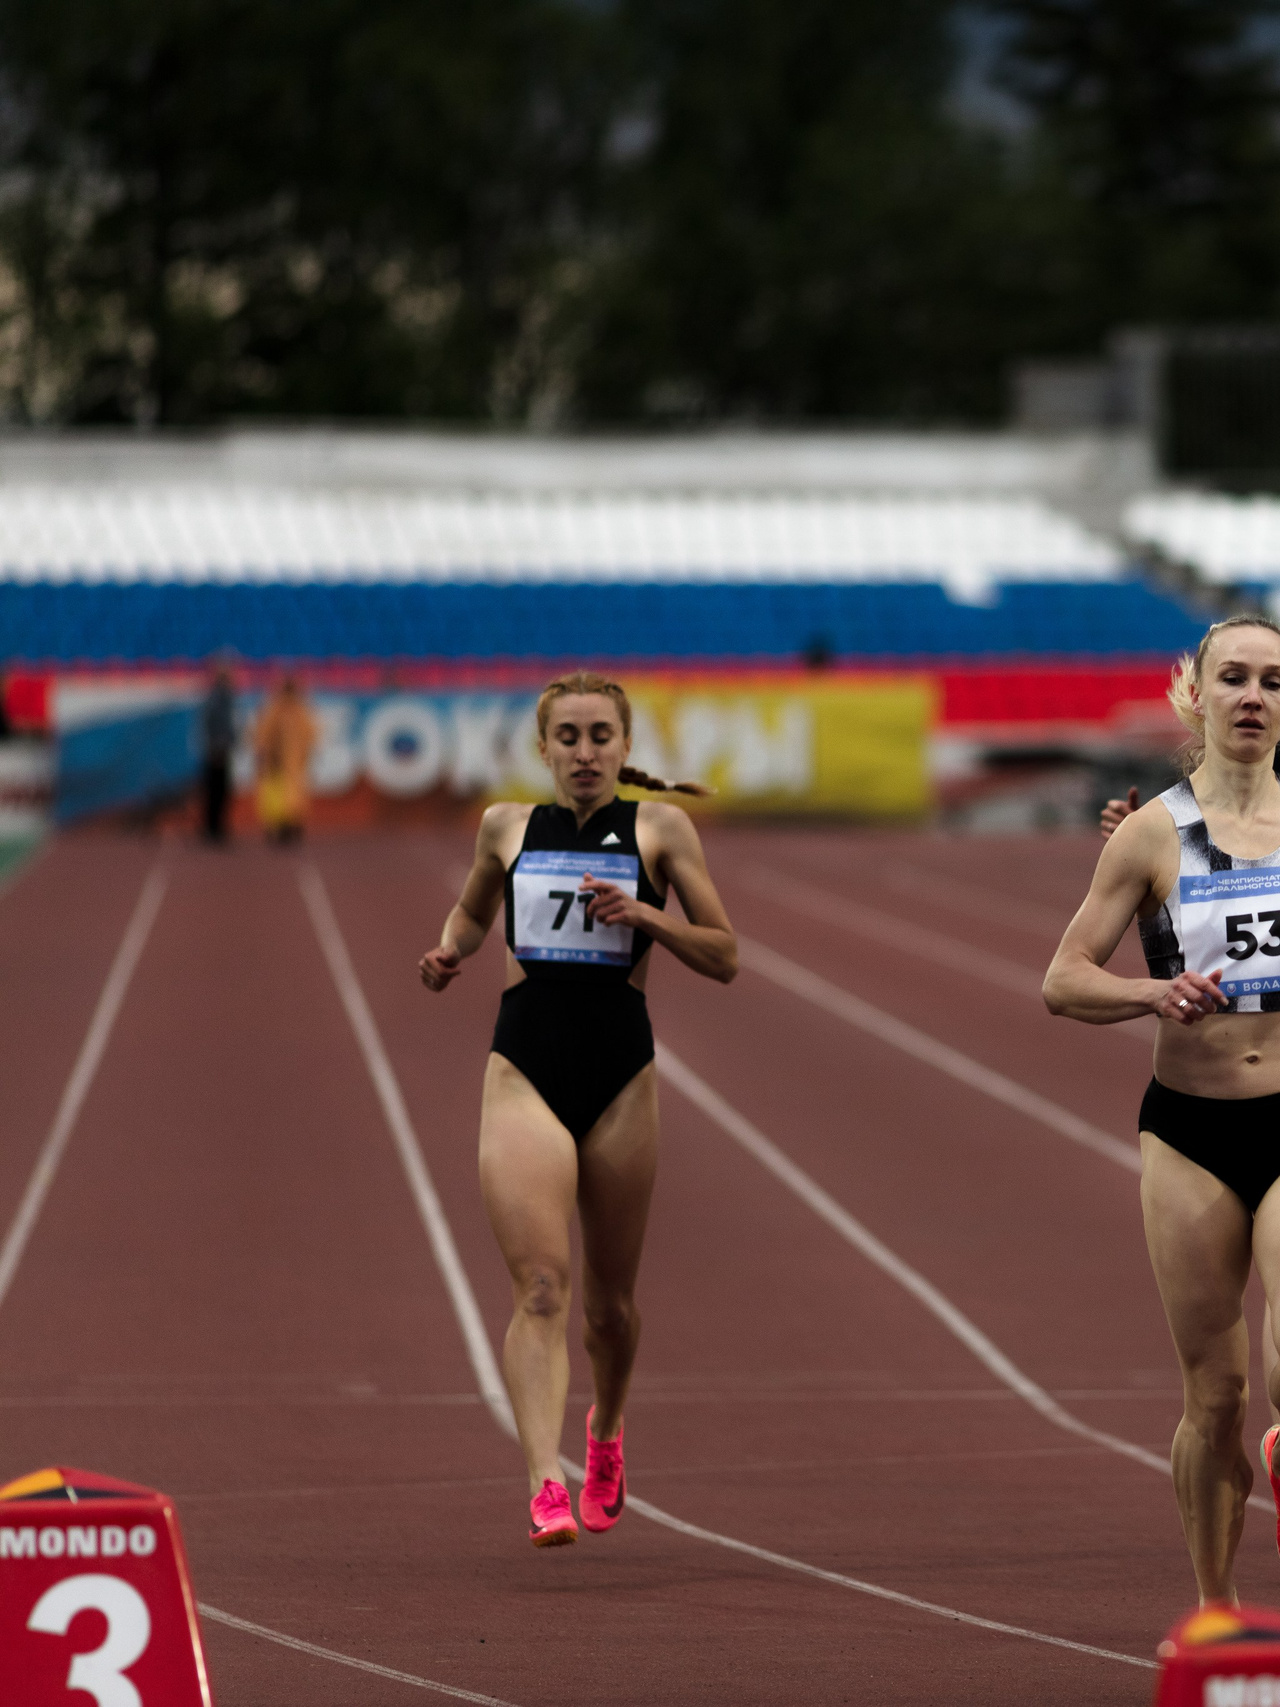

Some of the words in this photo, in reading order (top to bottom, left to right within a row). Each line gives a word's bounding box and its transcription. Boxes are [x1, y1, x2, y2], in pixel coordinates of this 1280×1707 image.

[1189, 881, 1272, 896] ФЕДЕРАЛЬНОГО
[1217, 874, 1280, 886] ЧЕМПИОНАТ
[548, 890, 597, 932] 71
[1243, 979, 1280, 992] ВФЛА
[0, 1524, 156, 1559] MONDO
[26, 1572, 152, 1707] 3
